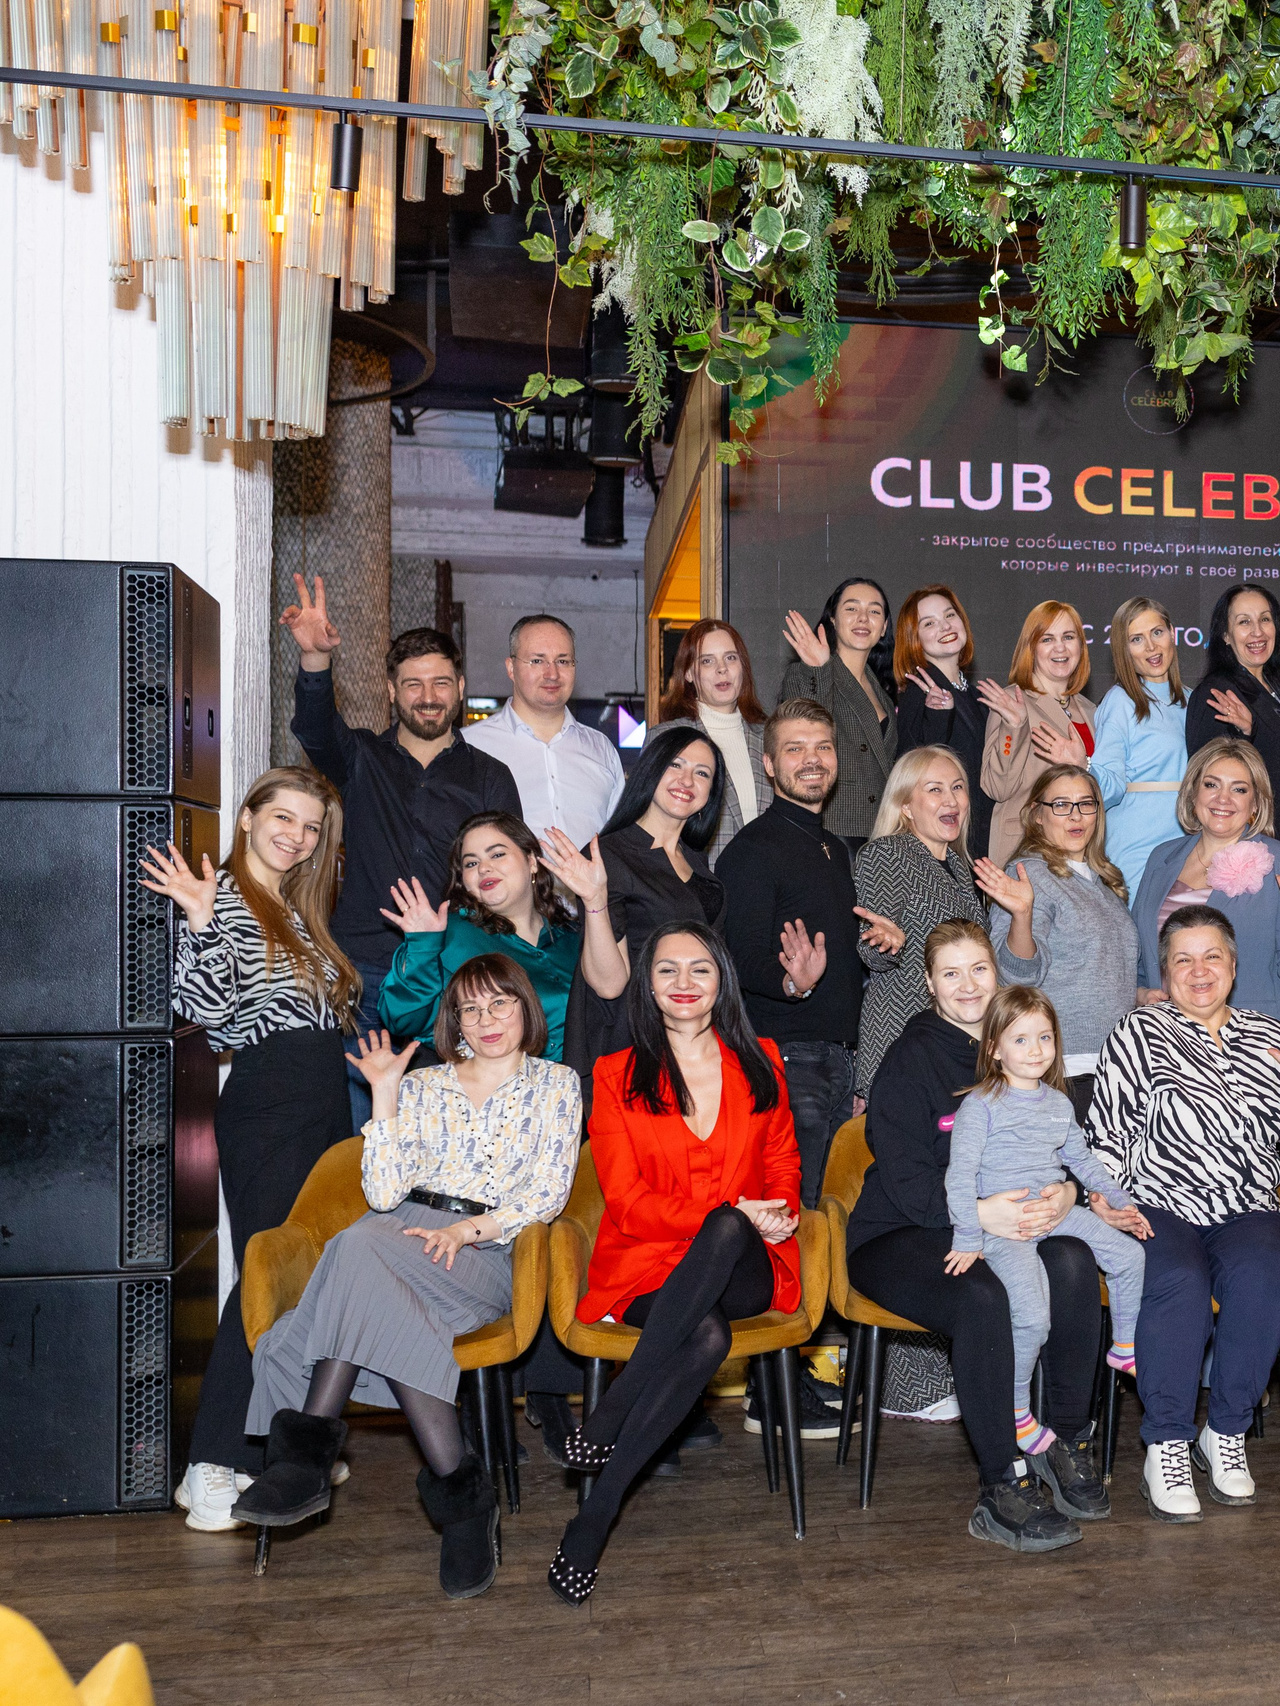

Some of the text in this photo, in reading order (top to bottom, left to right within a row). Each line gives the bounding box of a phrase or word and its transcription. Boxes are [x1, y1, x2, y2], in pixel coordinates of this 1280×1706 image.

[1144, 388, 1174, 398] CLUB
[870, 457, 1053, 512] CLUB
[932, 534, 1010, 550] закрытое
[1015, 534, 1116, 551] сообщество
[1001, 559, 1069, 574] которые
[1076, 561, 1179, 578] инвестируют
[1185, 566, 1193, 576] в
[1199, 563, 1237, 577] своё
